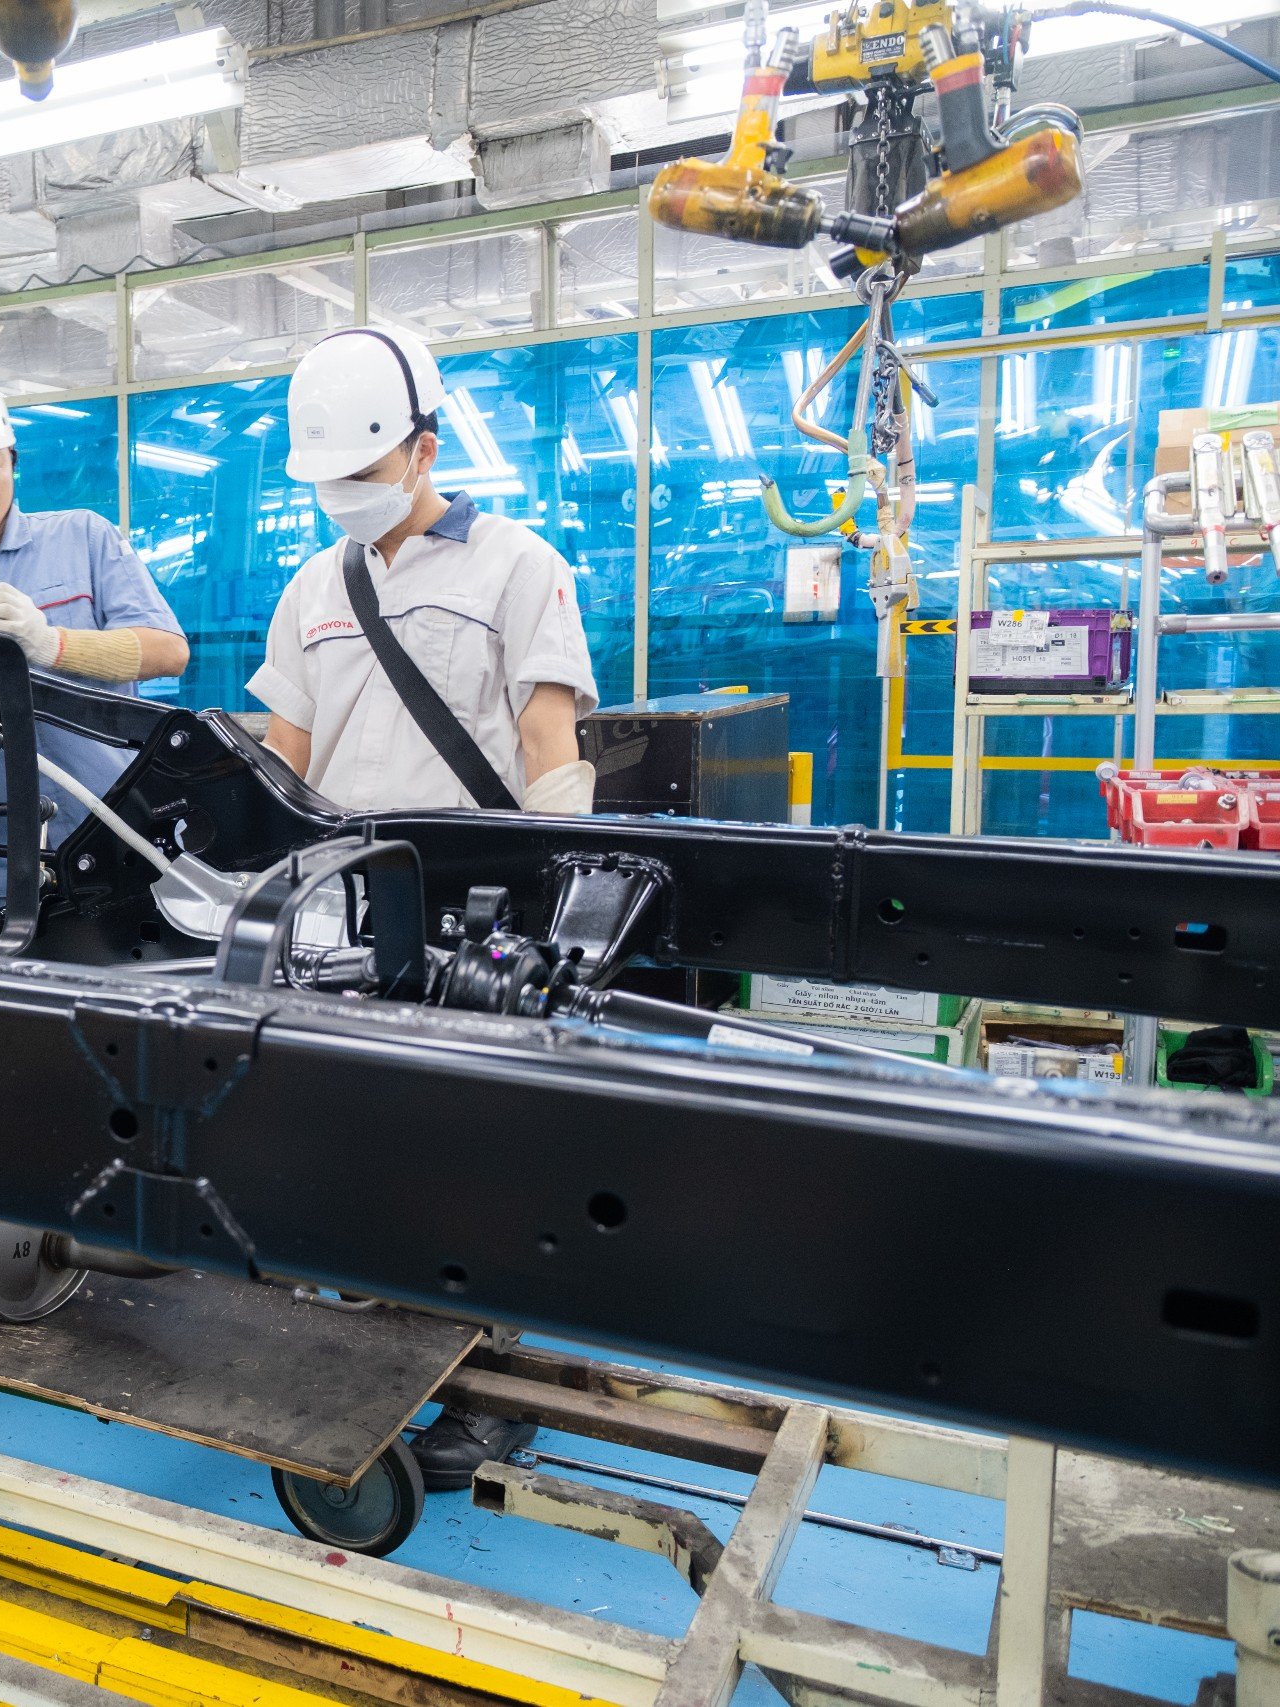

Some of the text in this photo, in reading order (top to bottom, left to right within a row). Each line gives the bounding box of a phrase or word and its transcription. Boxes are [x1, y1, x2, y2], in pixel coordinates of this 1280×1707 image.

[872, 35, 906, 50] ENDO
[317, 620, 354, 633] TOYOTA
[998, 620, 1023, 628] W286
[795, 990, 811, 998] Giấy
[846, 996, 866, 1004] nhựa
[1094, 1070, 1121, 1080] W193
